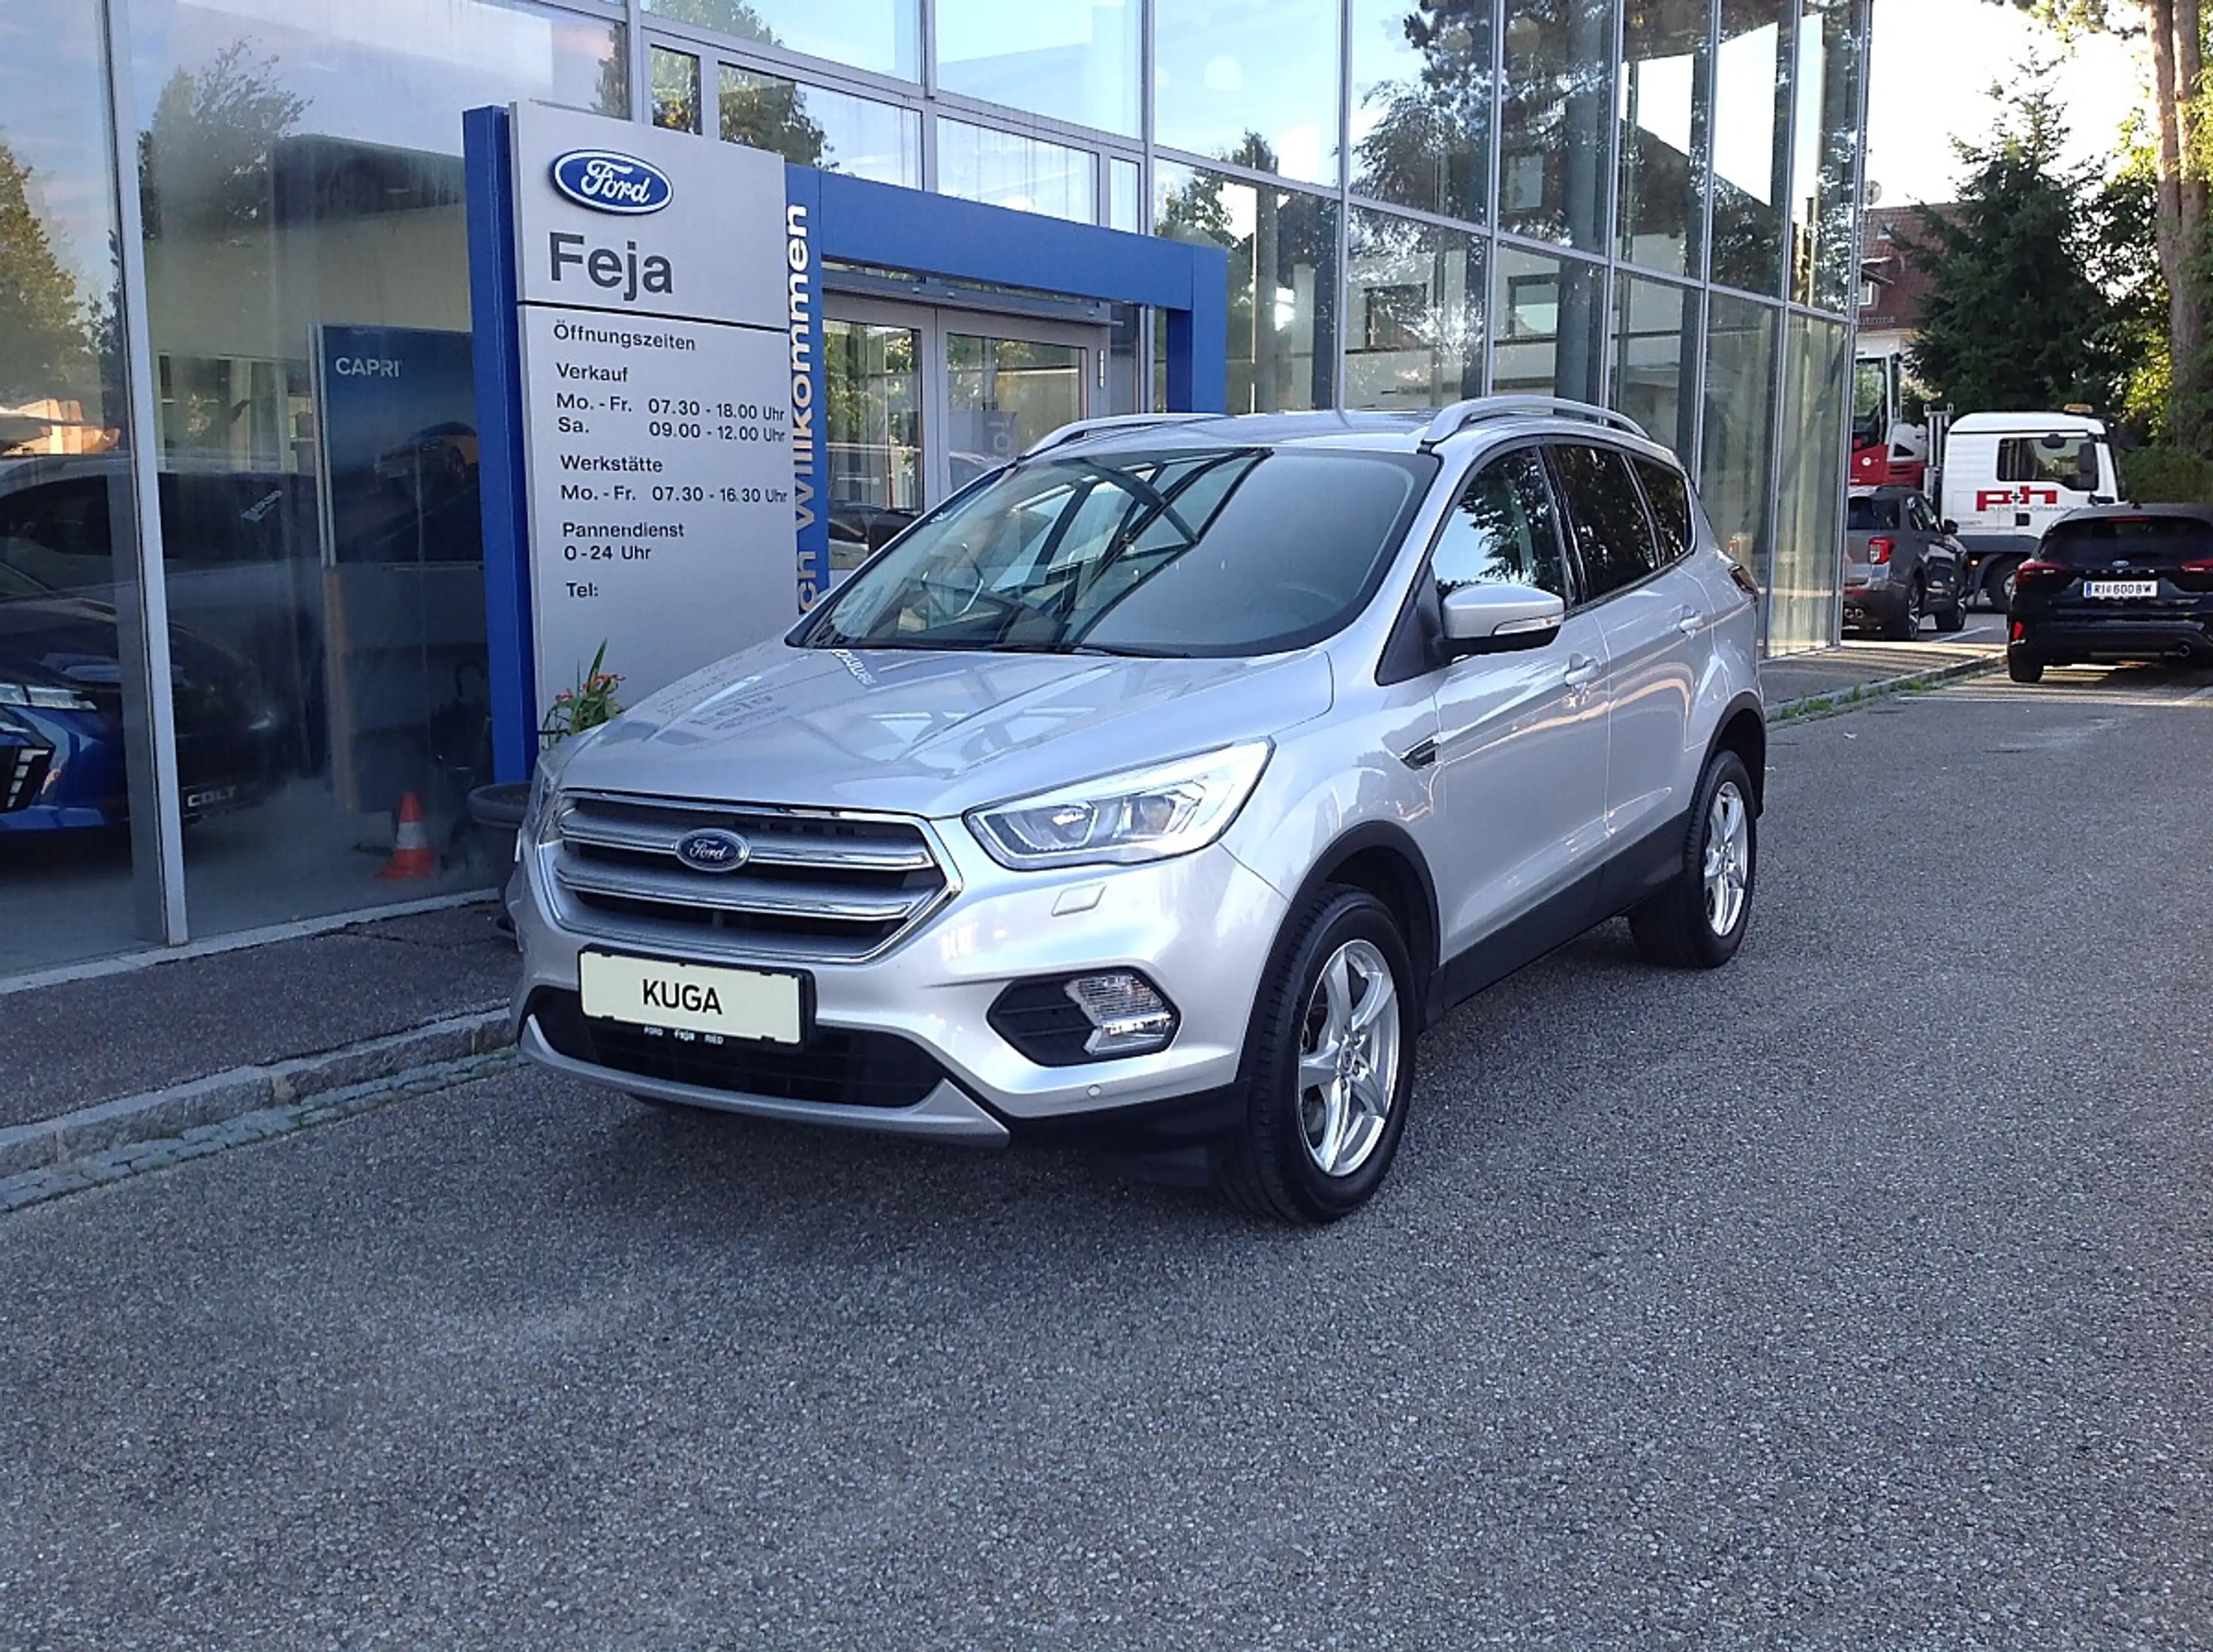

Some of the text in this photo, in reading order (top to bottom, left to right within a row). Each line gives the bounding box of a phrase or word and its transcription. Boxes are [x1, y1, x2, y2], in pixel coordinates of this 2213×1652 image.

[580, 157, 651, 205] Ford
[549, 231, 673, 301] Feja
[553, 319, 696, 351] Öffnungszeiten
[335, 357, 400, 377] CAPRI
[556, 362, 629, 383] Verkauf
[556, 392, 595, 411] Mo.
[610, 395, 633, 413] Fr.
[648, 398, 700, 417] 07.30
[716, 403, 758, 420] 18.00
[763, 406, 785, 421] Uhr
[558, 416, 590, 434] Sa.
[649, 421, 701, 438] 09.00
[716, 426, 758, 442] 12.00
[763, 428, 786, 443] Uhr
[560, 454, 663, 473] Werkstätte
[560, 484, 599, 501] Mo.
[613, 485, 636, 502] Fr.
[652, 486, 704, 502] 07.30
[719, 488, 761, 504] 16.30
[765, 489, 788, 504] Uhr
[562, 521, 685, 538] Pannendienst
[621, 545, 652, 560] Uhr
[566, 582, 599, 598] Tel:
[187, 786, 237, 807] COLT
[689, 838, 728, 861] Ford
[643, 978, 723, 1015] KUGA
